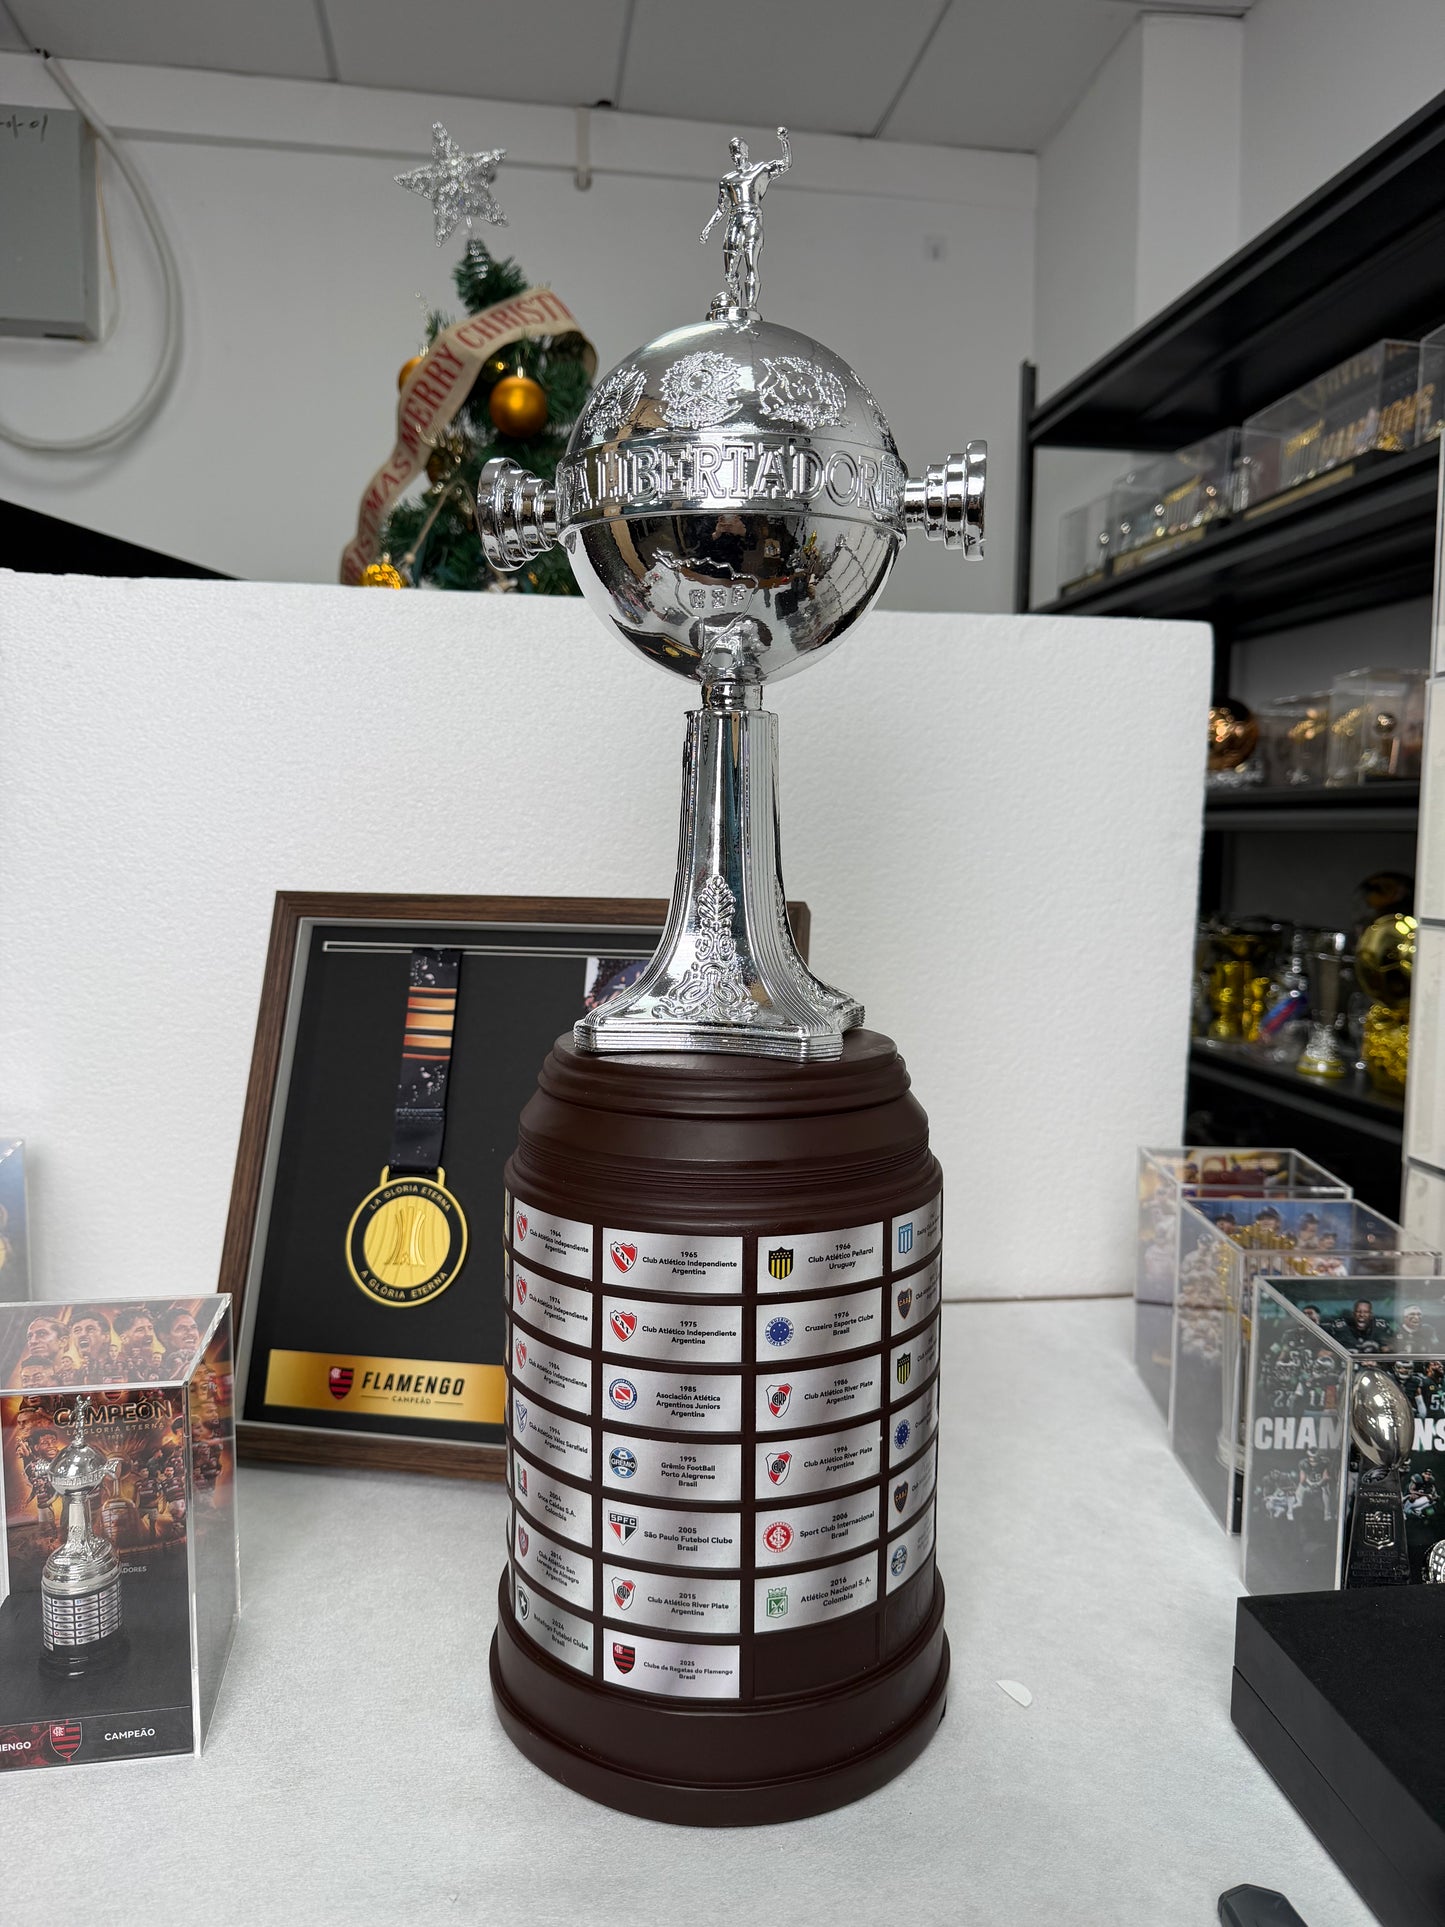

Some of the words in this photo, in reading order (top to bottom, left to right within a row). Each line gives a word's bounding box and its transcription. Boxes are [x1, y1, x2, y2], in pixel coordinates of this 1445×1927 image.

[400, 344, 466, 456] MERRY
[597, 442, 903, 517] LIBERTADORE
[369, 1199, 382, 1210] LA
[383, 1185, 419, 1198] GLORIA
[421, 1186, 452, 1212] ETERNA
[545, 1243, 567, 1255] Argentina
[835, 1243, 851, 1251] 1966
[808, 1256, 824, 1264] Club
[825, 1251, 851, 1262] Atlético
[852, 1246, 874, 1258] Peñarol
[642, 1256, 658, 1264] Club
[658, 1258, 686, 1266] Atlético
[687, 1260, 738, 1268] Independiente
[828, 1259, 857, 1271] Uruguay
[671, 1267, 707, 1275] Argentina
[360, 1270, 369, 1280] A
[410, 1271, 448, 1298] ETERNA
[544, 1309, 566, 1322] Argentina
[833, 1311, 849, 1319] 1976
[805, 1321, 833, 1332] Cruzeiro
[833, 1318, 857, 1328] Esporte
[857, 1313, 874, 1323] Clube
[641, 1325, 657, 1333] Club
[658, 1327, 685, 1335] Atlético
[686, 1329, 737, 1338] Independiente
[832, 1327, 850, 1336] Brasil
[671, 1336, 706, 1345] Argentina
[361, 1371, 466, 1396] FLAMENGO
[543, 1375, 566, 1389] Argentina
[833, 1378, 849, 1387] 1986
[680, 1385, 697, 1393] 1985
[804, 1392, 819, 1400] Club
[820, 1388, 844, 1398] Atlético
[844, 1384, 858, 1393] River
[859, 1380, 873, 1389] Plate
[392, 1395, 432, 1405] CAMPEÃO
[656, 1391, 692, 1401] Asociación
[693, 1393, 721, 1402] Atlética
[826, 1394, 855, 1405] Argentina
[656, 1400, 694, 1409] Argentinos
[694, 1402, 721, 1410] Juniors
[670, 1409, 705, 1418] Argentina
[126, 1422, 165, 1431] ETERNA
[833, 1445, 848, 1454] 1996
[679, 1455, 697, 1463] 1995
[803, 1459, 819, 1468] Club
[819, 1455, 843, 1465] Atlético
[844, 1451, 858, 1461] River
[859, 1446, 873, 1456] Plate
[661, 1462, 686, 1471] Grêmio
[686, 1464, 716, 1472] FootBall
[825, 1461, 855, 1472] Argentina
[661, 1470, 680, 1478] Porto
[681, 1472, 716, 1481] Alegrense
[678, 1480, 698, 1488] Brasil
[610, 1513, 636, 1526] SPFC
[832, 1512, 848, 1522] 2006
[678, 1526, 697, 1534] 2005
[800, 1529, 819, 1539] Sport
[820, 1524, 836, 1534] Club
[837, 1510, 875, 1529] Internacional
[643, 1530, 658, 1540] São
[659, 1532, 679, 1542] Paulo
[680, 1535, 710, 1544] Futebol
[711, 1536, 733, 1545] Clube
[831, 1529, 849, 1540] Brasil
[677, 1543, 698, 1552] Brasil
[830, 1576, 848, 1587] 2016
[678, 1592, 697, 1600] 2015
[800, 1591, 829, 1603] Atlético
[830, 1581, 858, 1596] Nacional
[647, 1596, 663, 1604] Club
[663, 1598, 691, 1608] Atlético
[691, 1601, 710, 1609] River
[711, 1602, 729, 1610] Plate
[822, 1592, 854, 1607] Colombia
[670, 1607, 705, 1617] Argentina
[643, 1661, 660, 1670] Clube
[669, 1665, 694, 1674] Regatas
[703, 1668, 734, 1676] Flamengo
[678, 1673, 697, 1681] Brasil
[104, 1727, 156, 1741] CAMPEÃO
